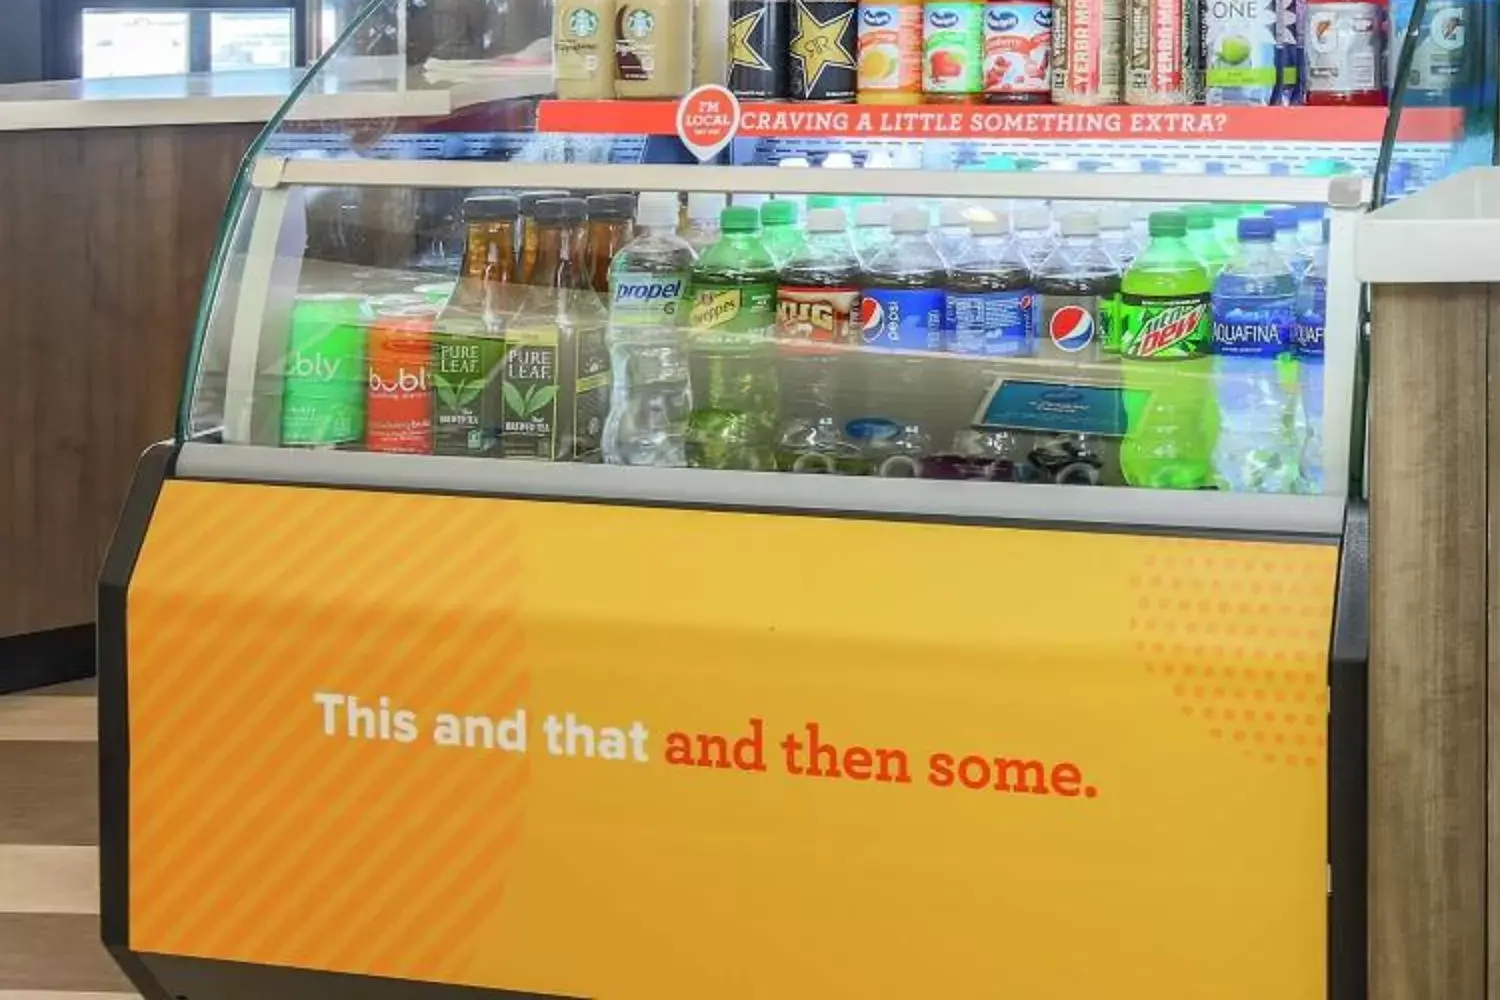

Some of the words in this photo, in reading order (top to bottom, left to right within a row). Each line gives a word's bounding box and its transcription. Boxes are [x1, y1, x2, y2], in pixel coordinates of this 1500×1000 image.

[1212, 1, 1259, 19] ONE
[741, 111, 850, 131] CRAVING
[856, 112, 873, 131] A
[880, 112, 963, 132] LITTLE
[969, 112, 1121, 133] SOMETHING
[1130, 113, 1228, 133] EXTRA?
[614, 280, 681, 301] propel
[441, 345, 480, 359] PURE
[313, 692, 418, 743] This
[432, 709, 527, 753] and
[542, 711, 649, 763] that
[664, 717, 766, 773] and
[779, 721, 912, 784] then
[927, 750, 1098, 800] some.
